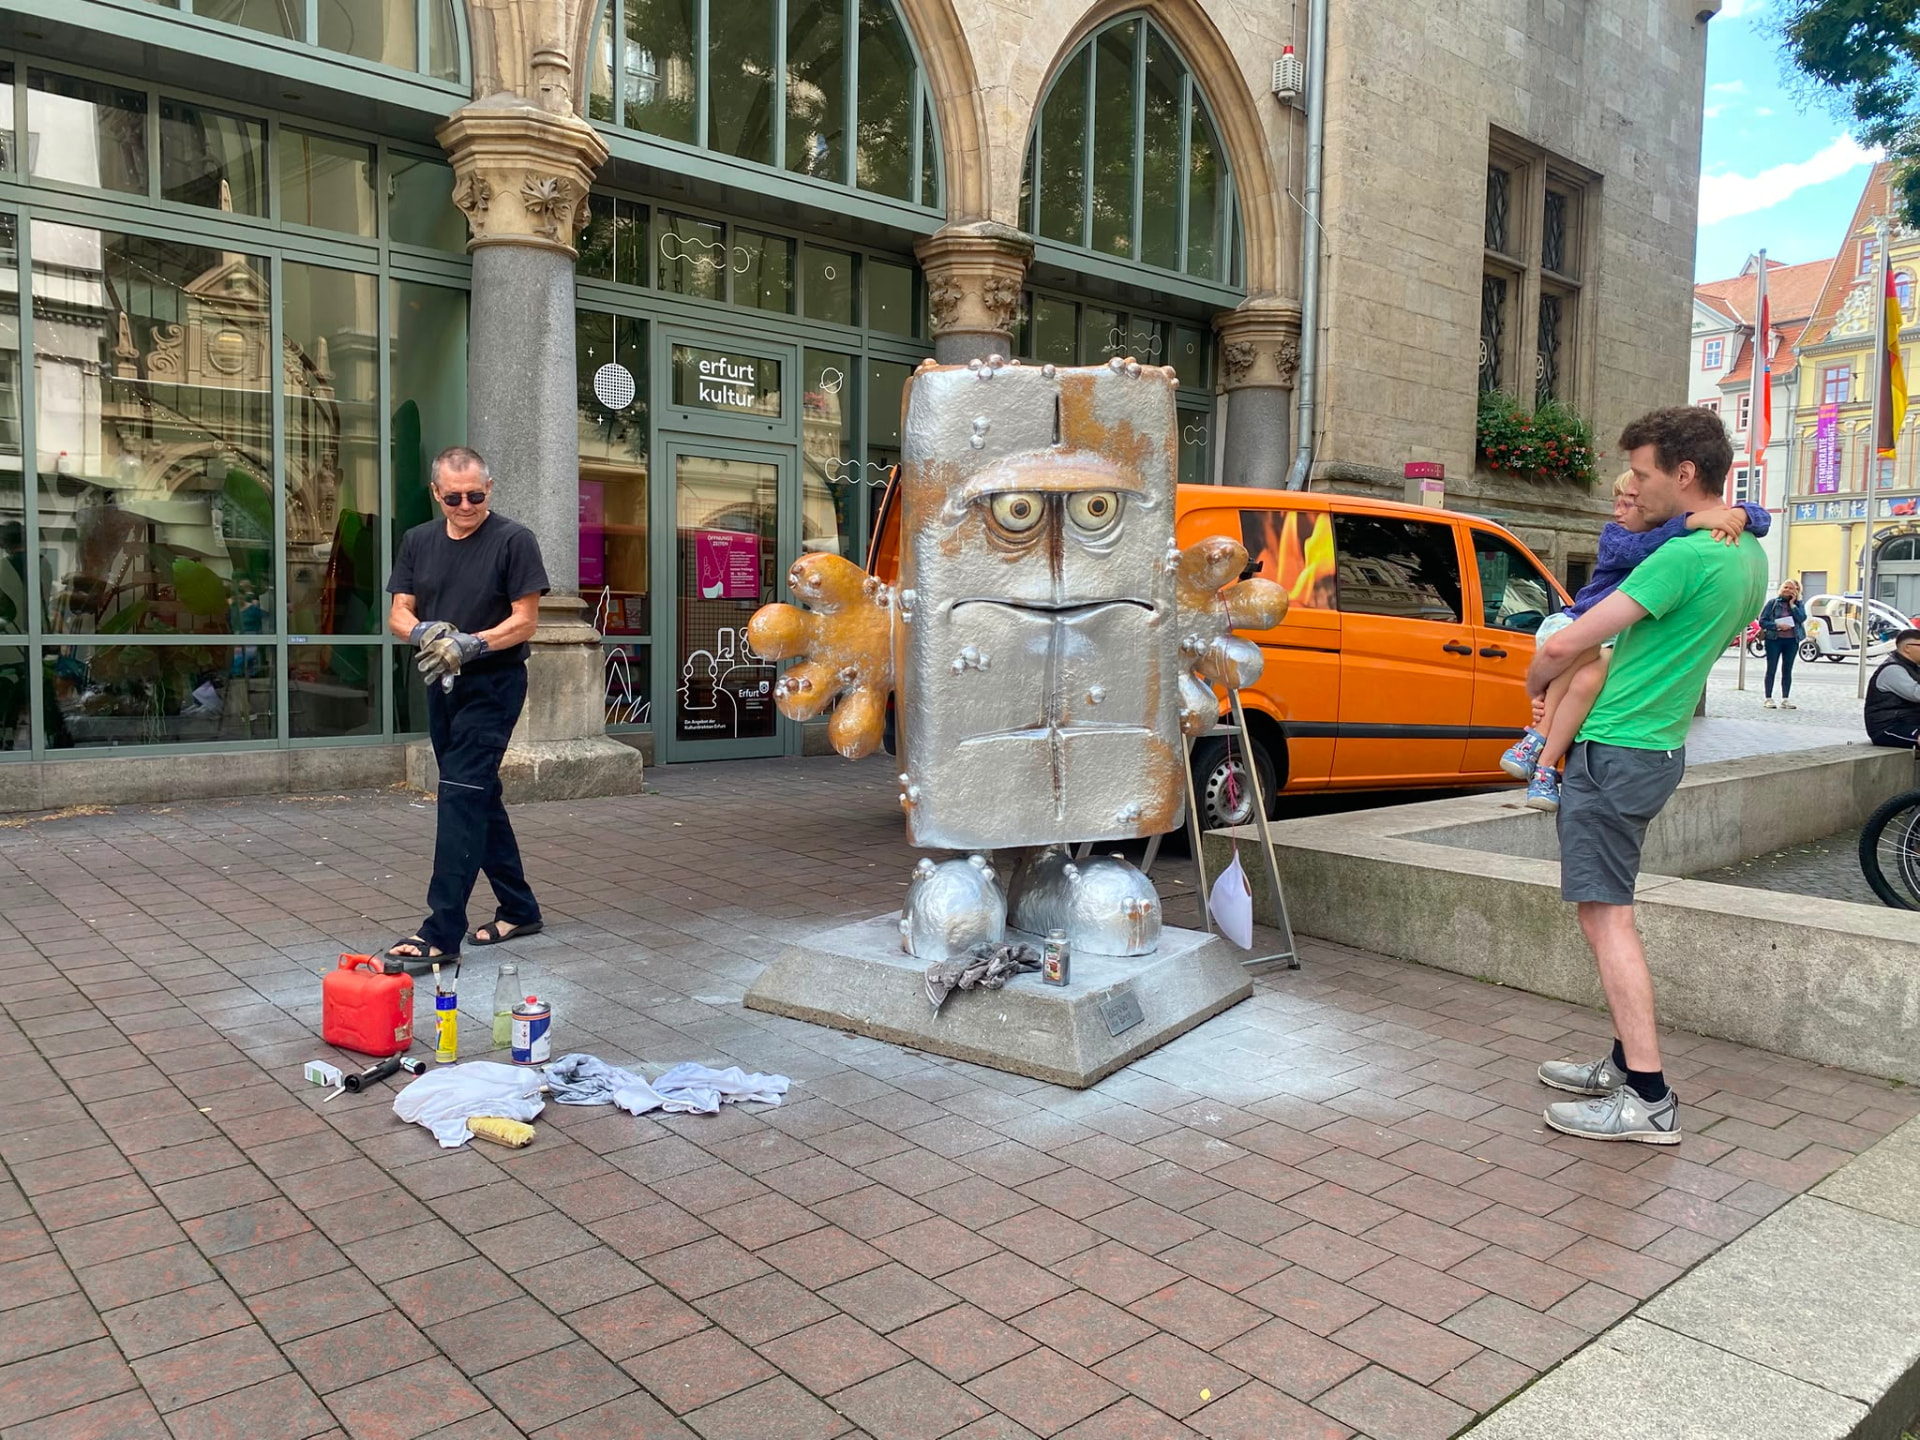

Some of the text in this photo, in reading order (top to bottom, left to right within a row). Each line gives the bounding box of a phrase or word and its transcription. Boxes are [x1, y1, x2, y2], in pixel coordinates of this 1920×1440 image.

[699, 357, 755, 381] erfurt
[699, 382, 755, 407] kultur
[1819, 438, 1828, 484] DEMOKRATIE
[738, 688, 760, 698] Erfurt
